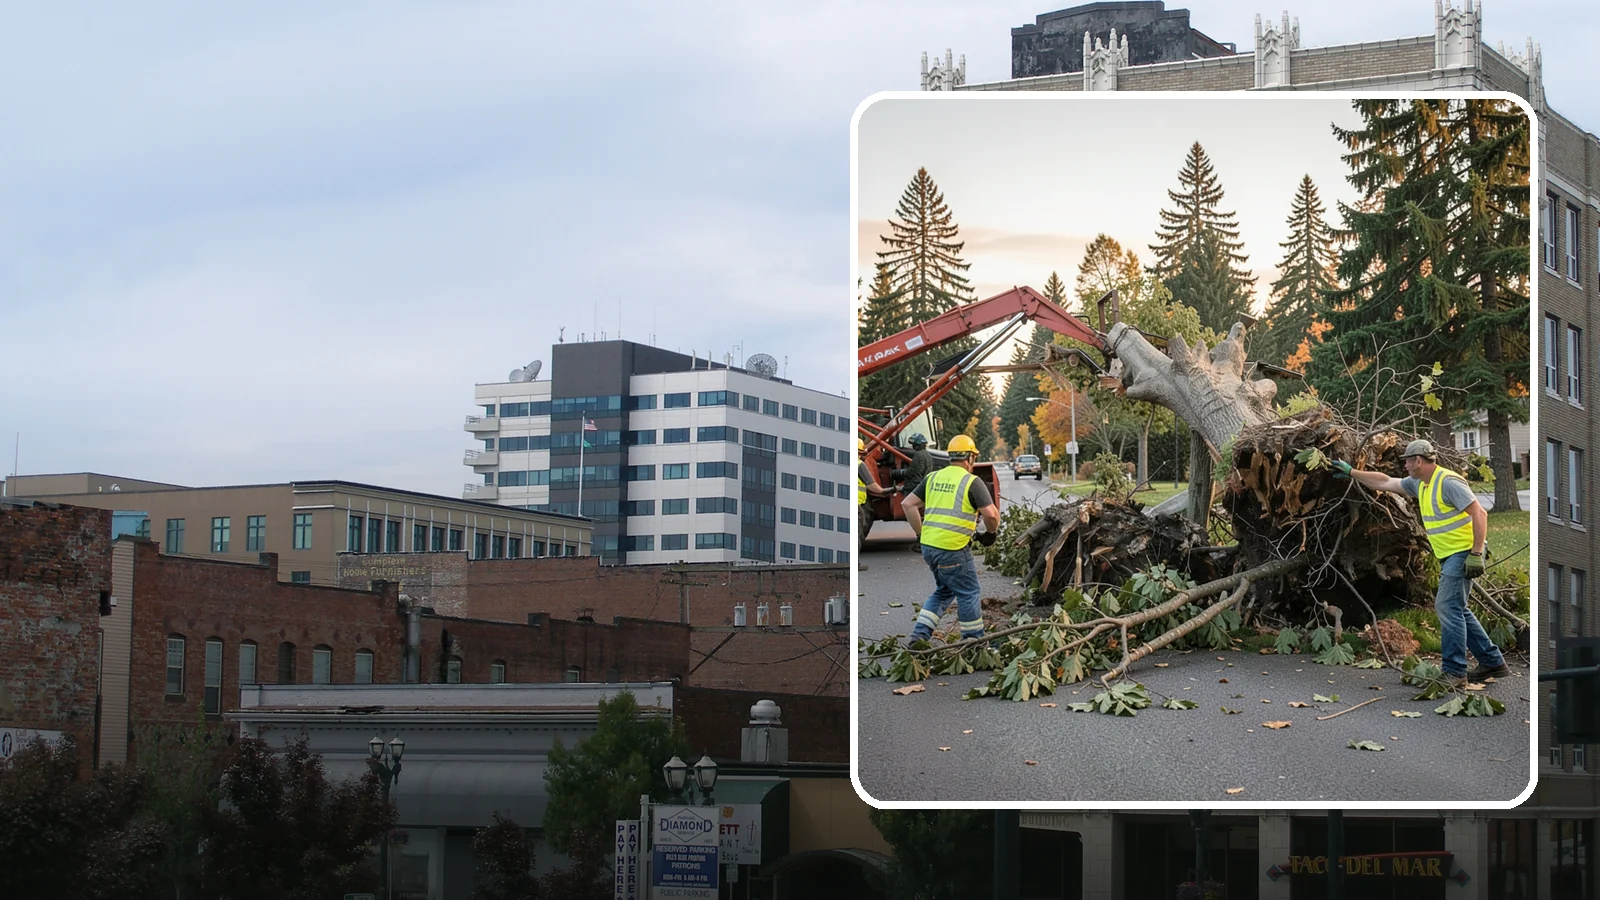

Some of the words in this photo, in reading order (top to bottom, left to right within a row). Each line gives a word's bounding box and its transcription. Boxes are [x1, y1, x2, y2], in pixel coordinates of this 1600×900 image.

[343, 568, 367, 577] Home
[370, 566, 427, 577] Furnishers
[660, 818, 713, 833] DIAMOND
[1022, 815, 1070, 828] BUILDING
[617, 824, 625, 852] PAY
[628, 824, 636, 852] PAY
[656, 845, 688, 853] RESERVED
[690, 846, 716, 854] PARKING
[721, 851, 739, 862] Soup
[1345, 856, 1385, 875] DEL
[1392, 857, 1443, 876] MAR
[616, 855, 625, 893] HERE
[628, 855, 636, 893] HERE
[660, 889, 682, 897] PUBLIC
[683, 889, 710, 898] PARKING
